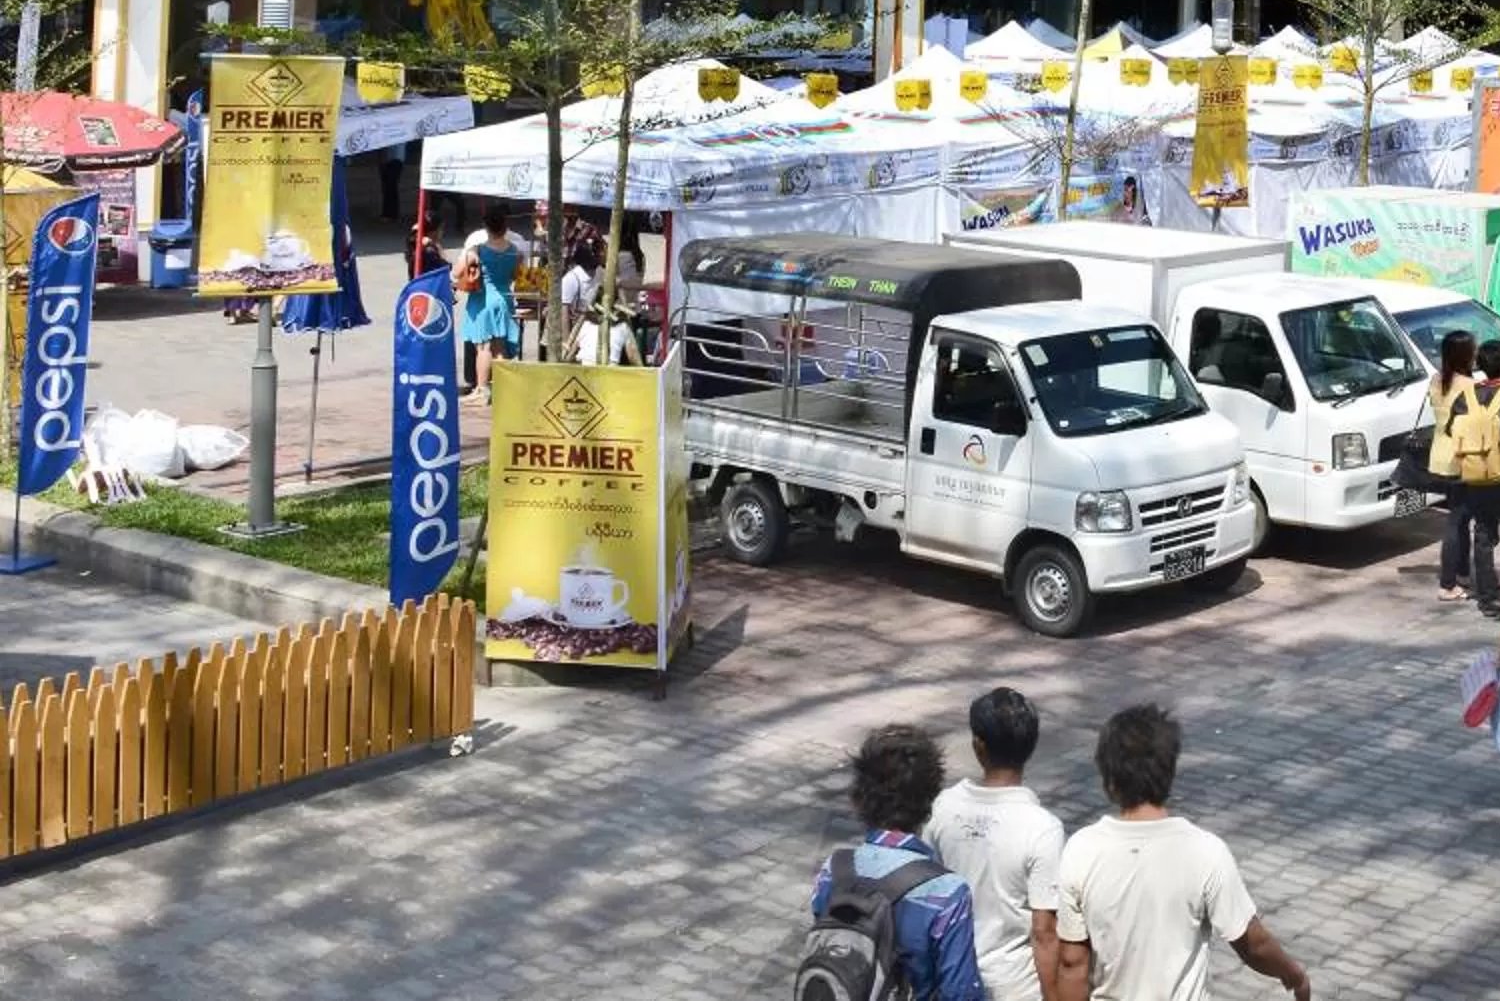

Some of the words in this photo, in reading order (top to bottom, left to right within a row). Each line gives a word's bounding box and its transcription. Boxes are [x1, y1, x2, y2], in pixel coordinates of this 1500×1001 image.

[221, 110, 325, 130] PREMIER
[213, 136, 331, 144] COFFEE
[1299, 217, 1377, 256] WASUKA
[34, 285, 87, 452] pepsi
[400, 372, 461, 563] pepsi
[511, 441, 636, 472] PREMIER
[503, 476, 645, 492] COFFEE
